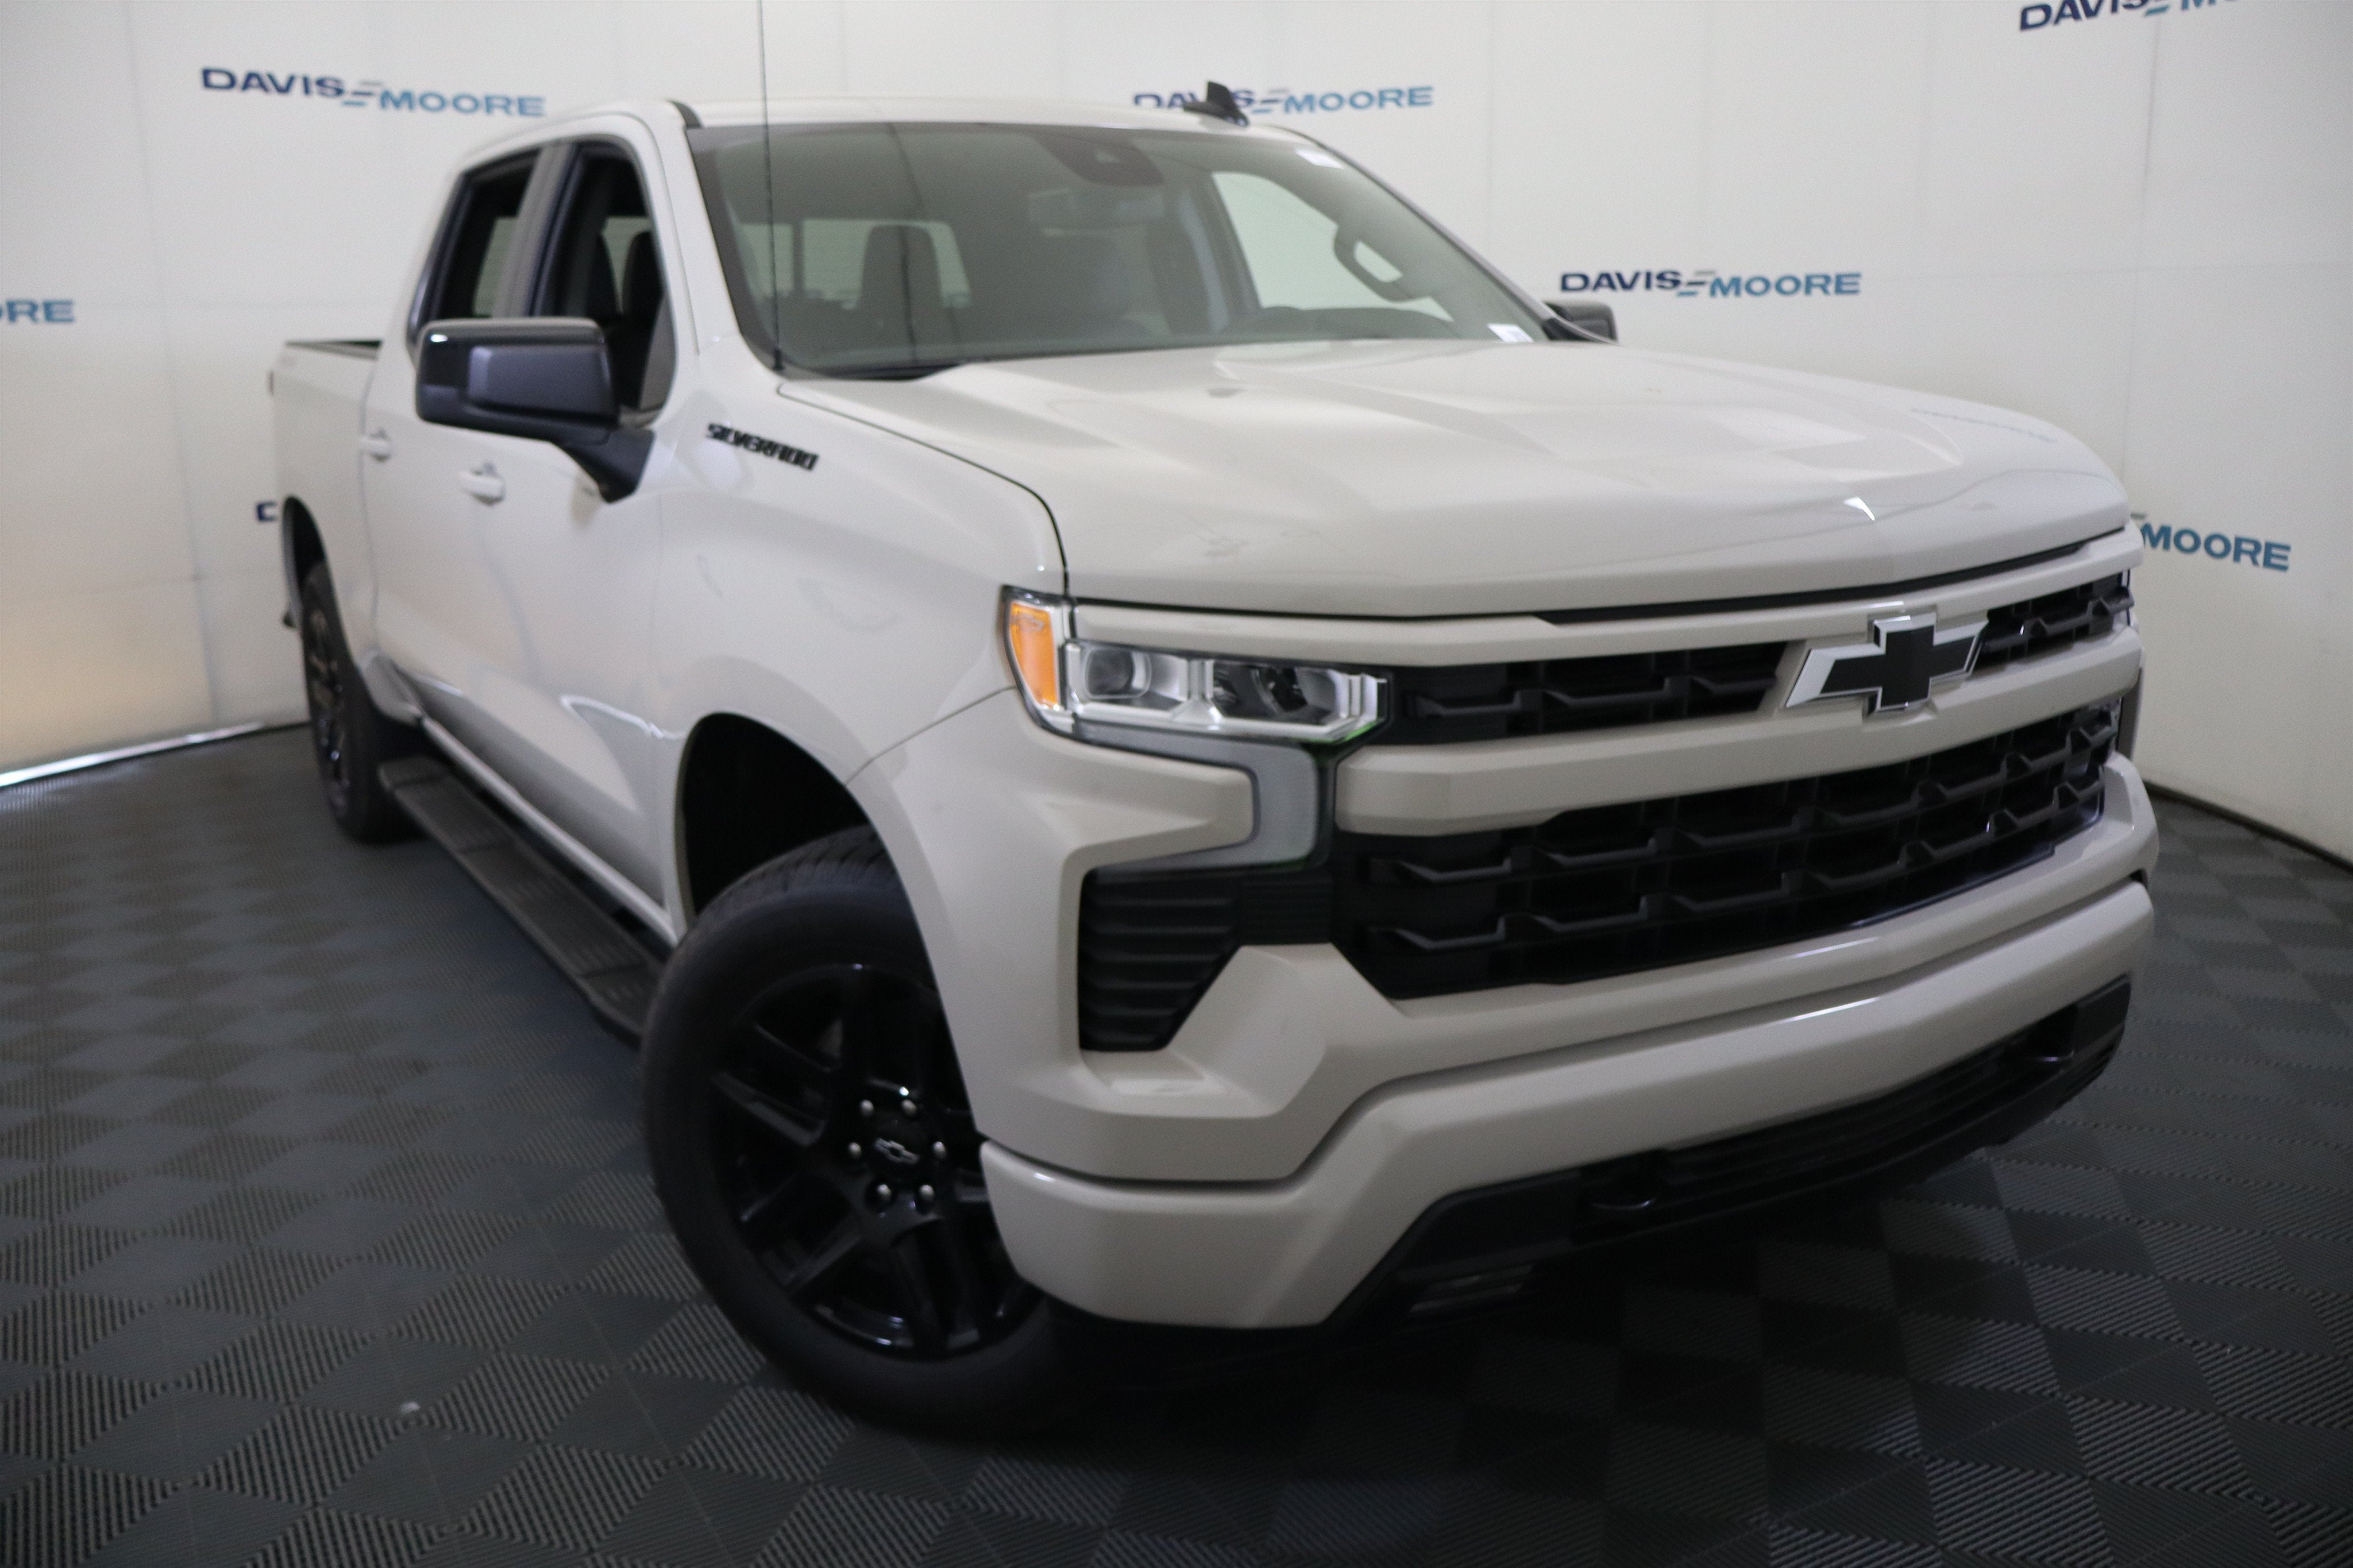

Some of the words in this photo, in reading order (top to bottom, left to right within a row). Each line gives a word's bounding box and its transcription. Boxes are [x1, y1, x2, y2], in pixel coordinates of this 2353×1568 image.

[200, 66, 346, 98] DAVIS
[379, 88, 545, 117] MOORE
[1283, 86, 1434, 114] MOORE
[1560, 270, 1682, 292] DAVIS
[1708, 272, 1862, 298] MOORE
[2140, 522, 2292, 573] MOORE
